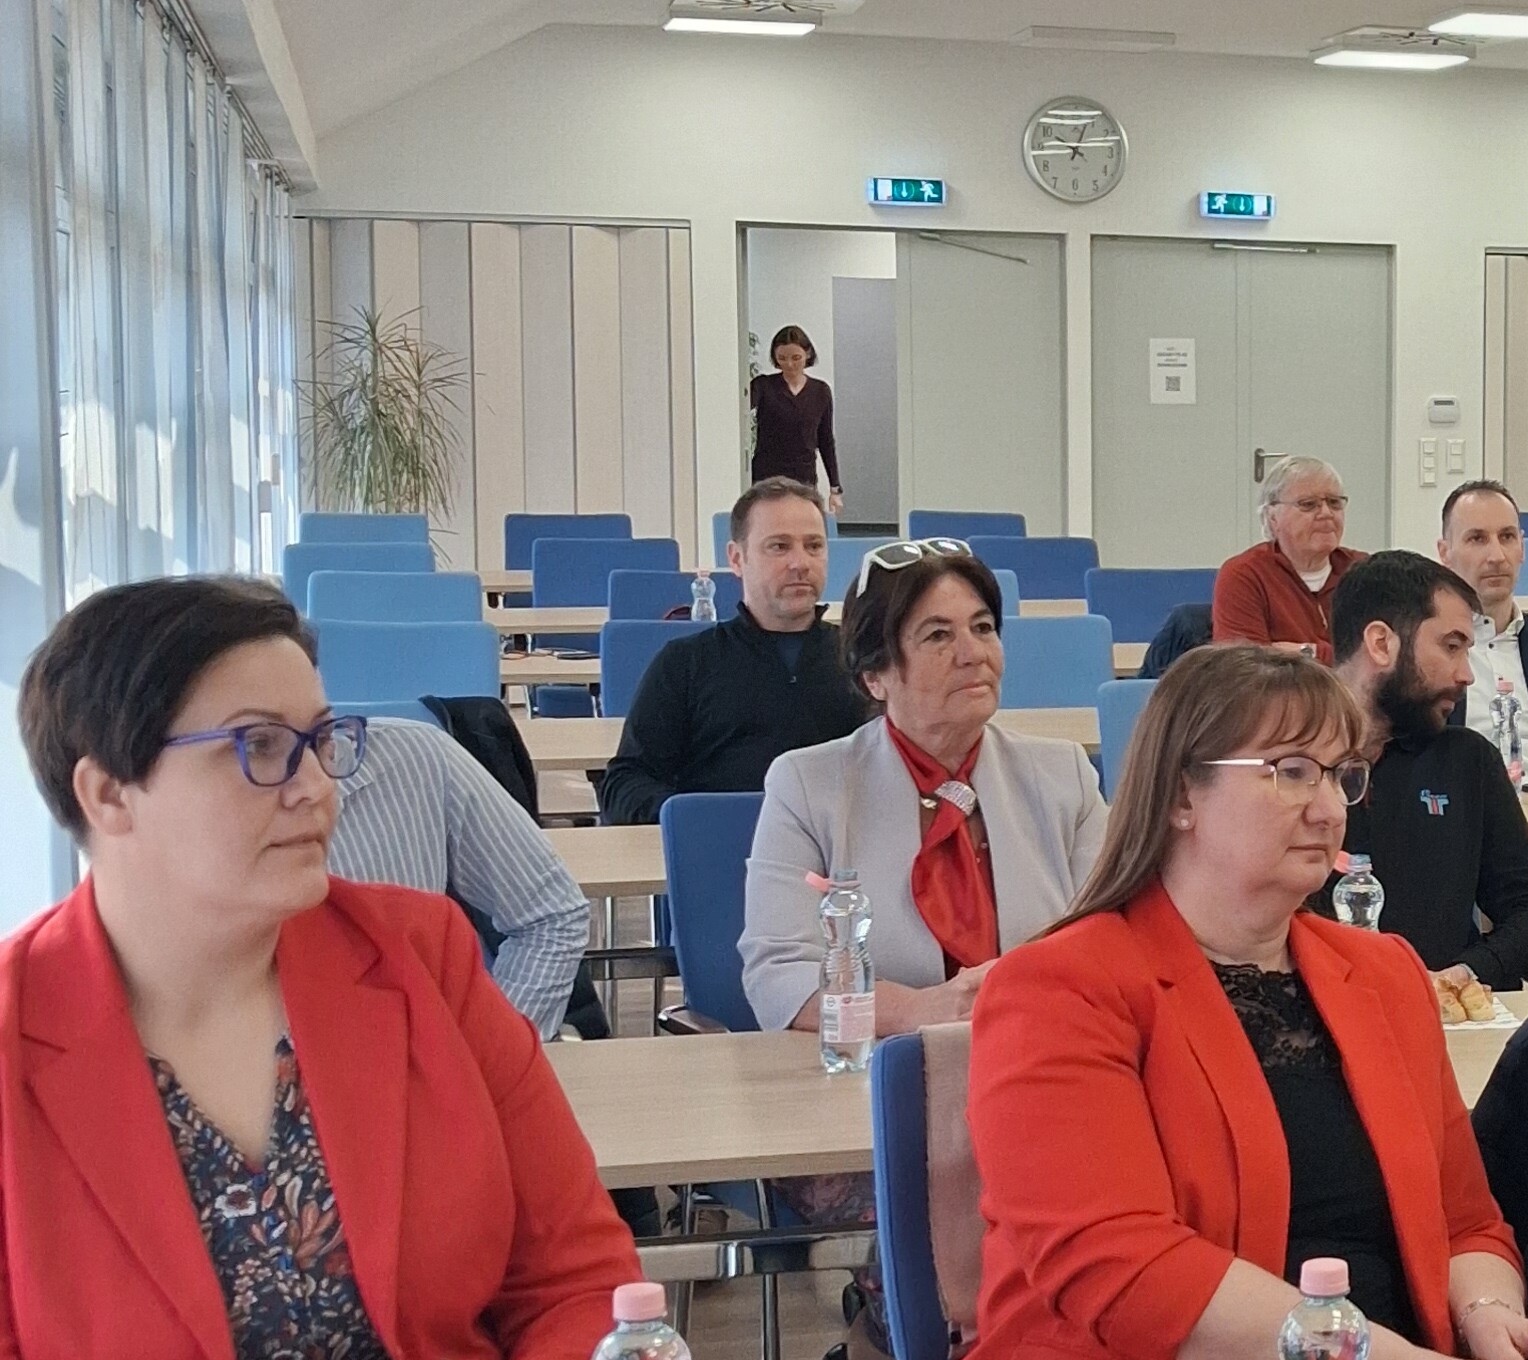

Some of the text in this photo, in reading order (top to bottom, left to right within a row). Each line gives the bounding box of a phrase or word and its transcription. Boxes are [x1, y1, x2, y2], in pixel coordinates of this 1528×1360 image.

[1042, 125, 1053, 138] 10
[1107, 146, 1114, 159] 3
[1042, 160, 1050, 172] 8
[1101, 164, 1108, 177] 4
[1052, 176, 1058, 189] 7
[1072, 178, 1079, 191] 6
[1092, 179, 1099, 191] 5
